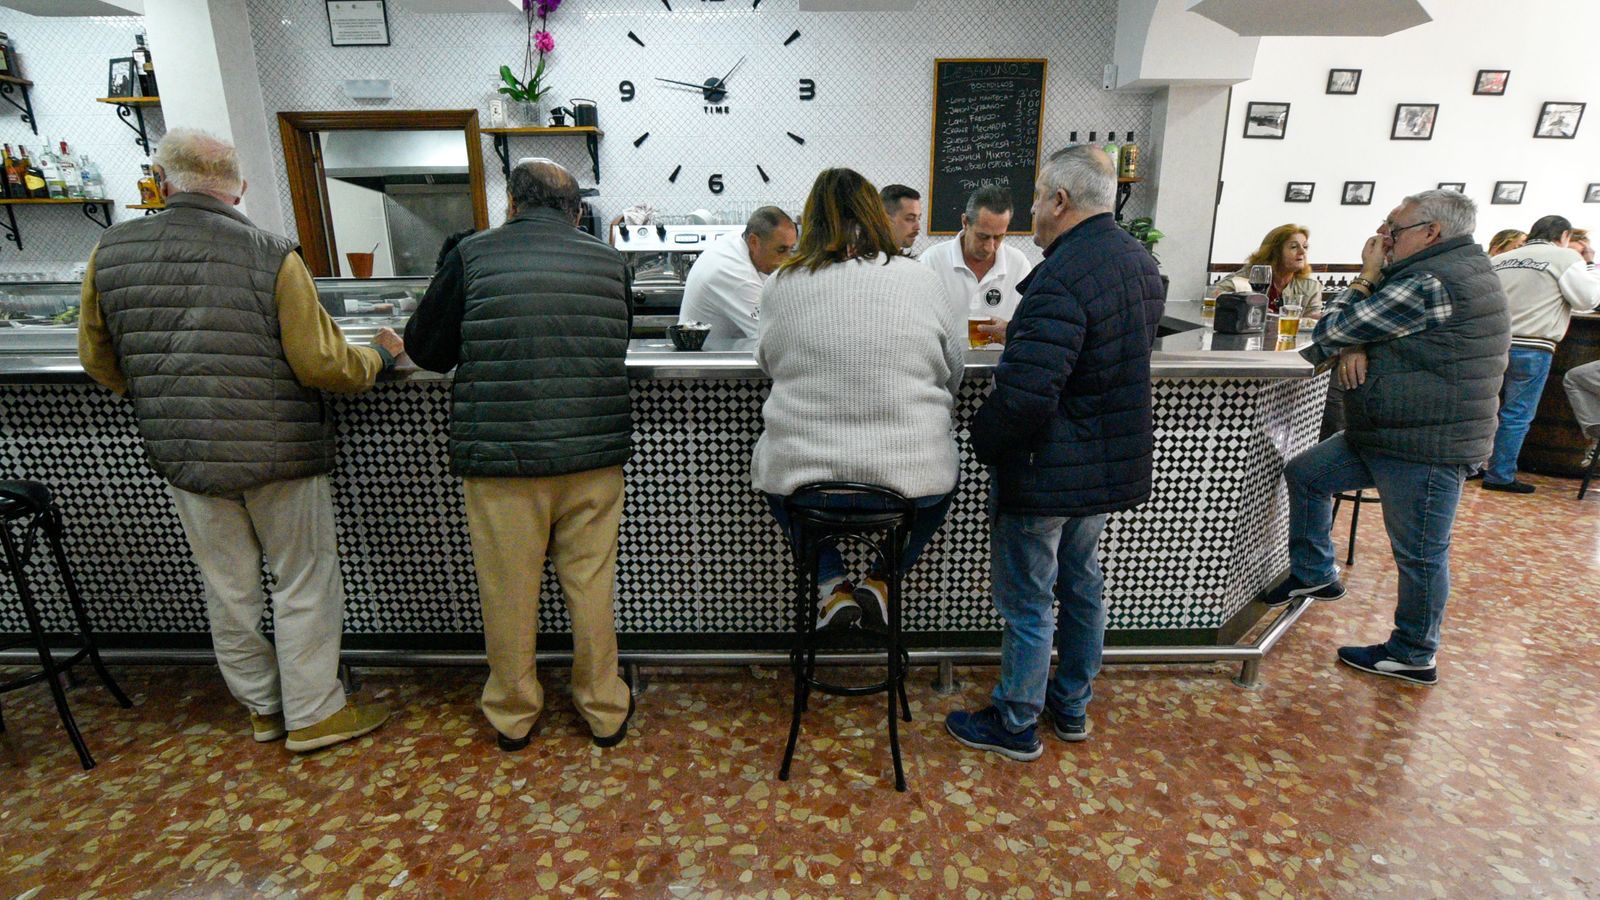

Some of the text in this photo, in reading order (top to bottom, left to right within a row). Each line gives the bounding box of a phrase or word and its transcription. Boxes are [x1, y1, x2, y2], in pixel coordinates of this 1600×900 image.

[619, 80, 635, 101] 9
[799, 79, 815, 100] 3
[704, 106, 730, 114] TIME
[708, 174, 724, 194] 6
[959, 179, 979, 190] PAN
